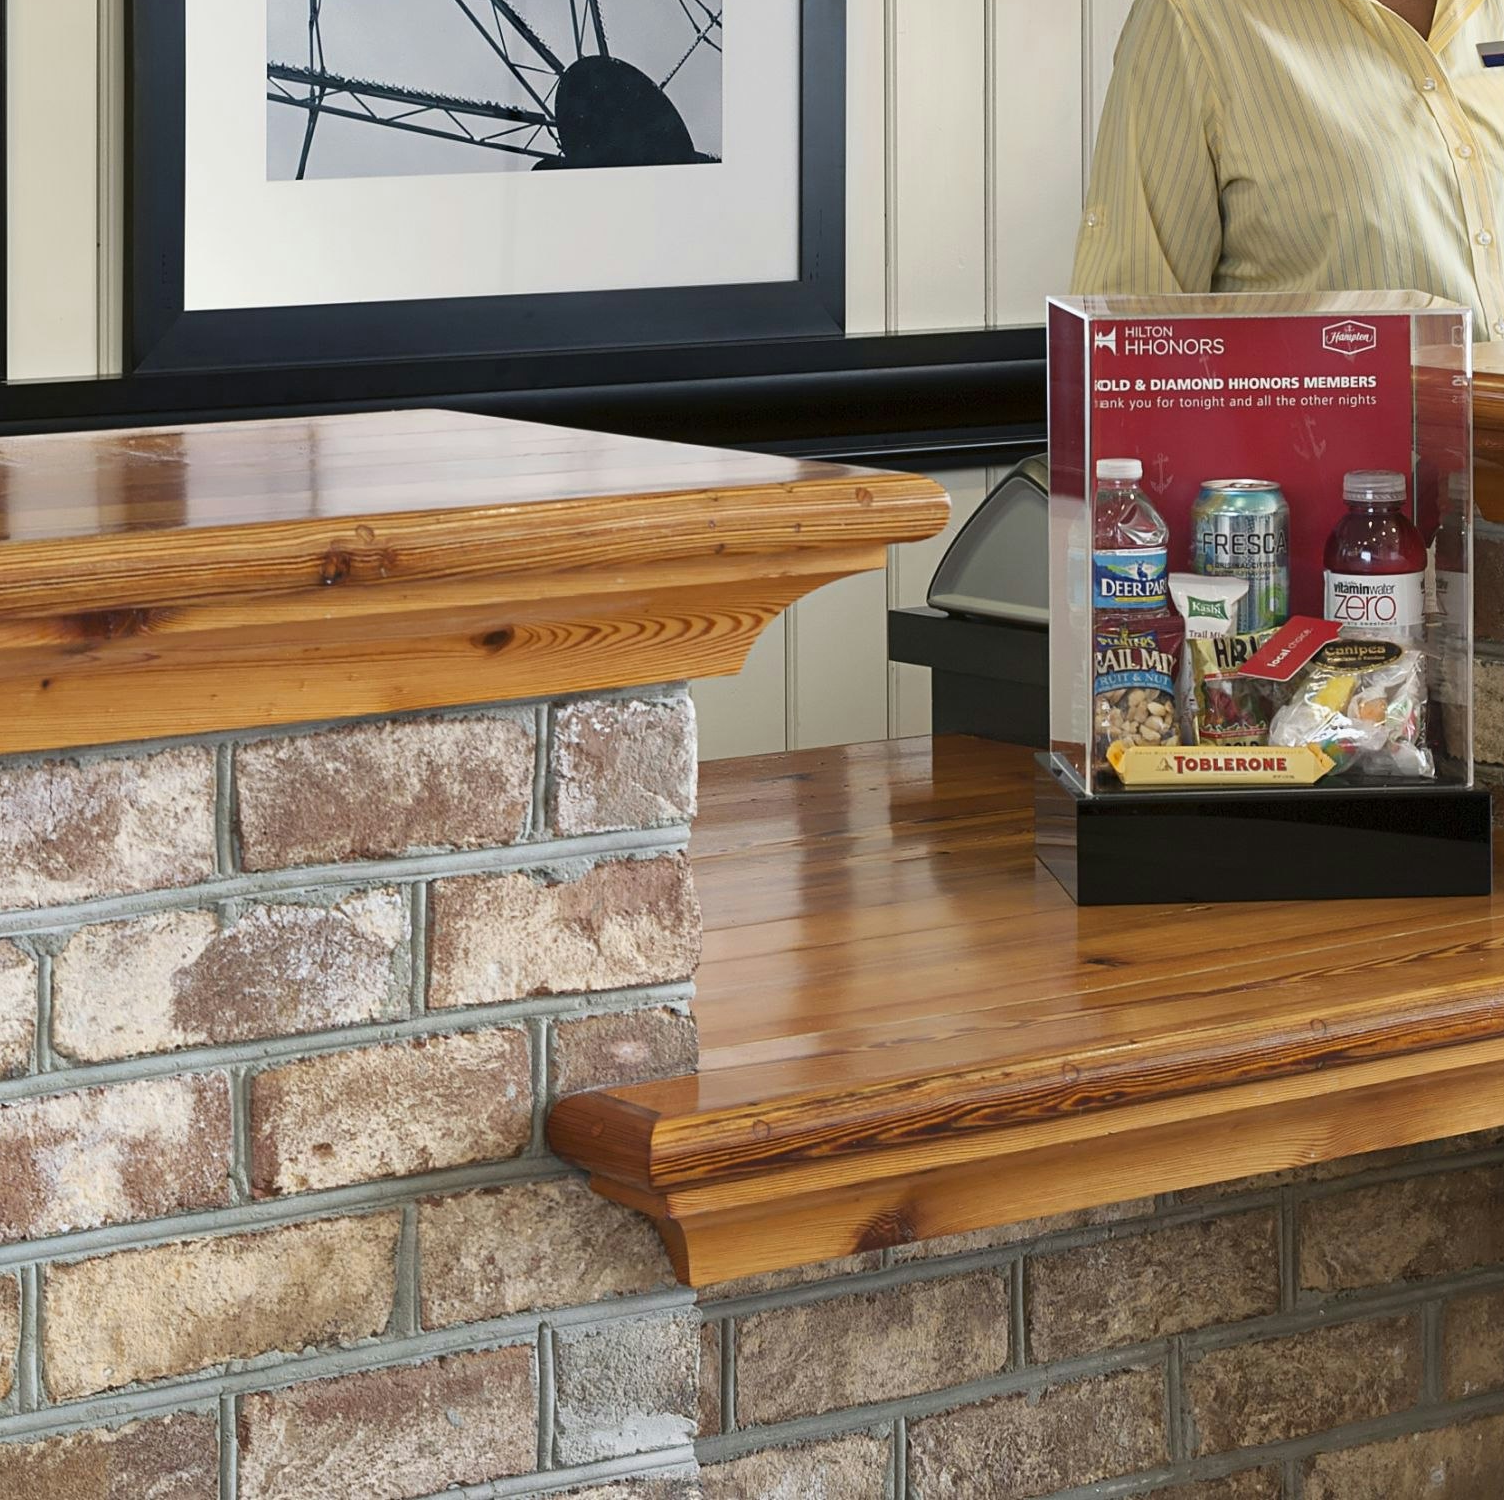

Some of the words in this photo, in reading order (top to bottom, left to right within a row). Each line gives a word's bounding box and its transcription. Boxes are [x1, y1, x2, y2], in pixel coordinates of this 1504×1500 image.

[1125, 326, 1173, 338] HILTON
[1326, 331, 1374, 345] Hampton
[1125, 338, 1225, 356] HHONORS
[1135, 379, 1146, 391] &
[1150, 378, 1224, 391] DIAMOND
[1228, 377, 1300, 390] HHONORS
[1304, 376, 1377, 389] MEMBERS
[1095, 397, 1125, 409] ank
[1129, 399, 1151, 411] you
[1156, 396, 1174, 408] for
[1179, 396, 1225, 410] tonight
[1229, 395, 1252, 407] and
[1257, 395, 1271, 406] all
[1276, 395, 1296, 406] the
[1300, 394, 1334, 406] other
[1338, 394, 1377, 408] nights
[1202, 532, 1287, 555] FRESCA
[1101, 578, 1144, 596] DEER
[1334, 581, 1395, 595] vitaminwater
[1192, 601, 1222, 615] Kashi
[1334, 594, 1397, 621] zero
[1189, 630, 1208, 638] Trail
[1266, 648, 1292, 668] local
[1145, 673, 1169, 685] NUT
[1174, 755, 1287, 774] TOBLERONE
